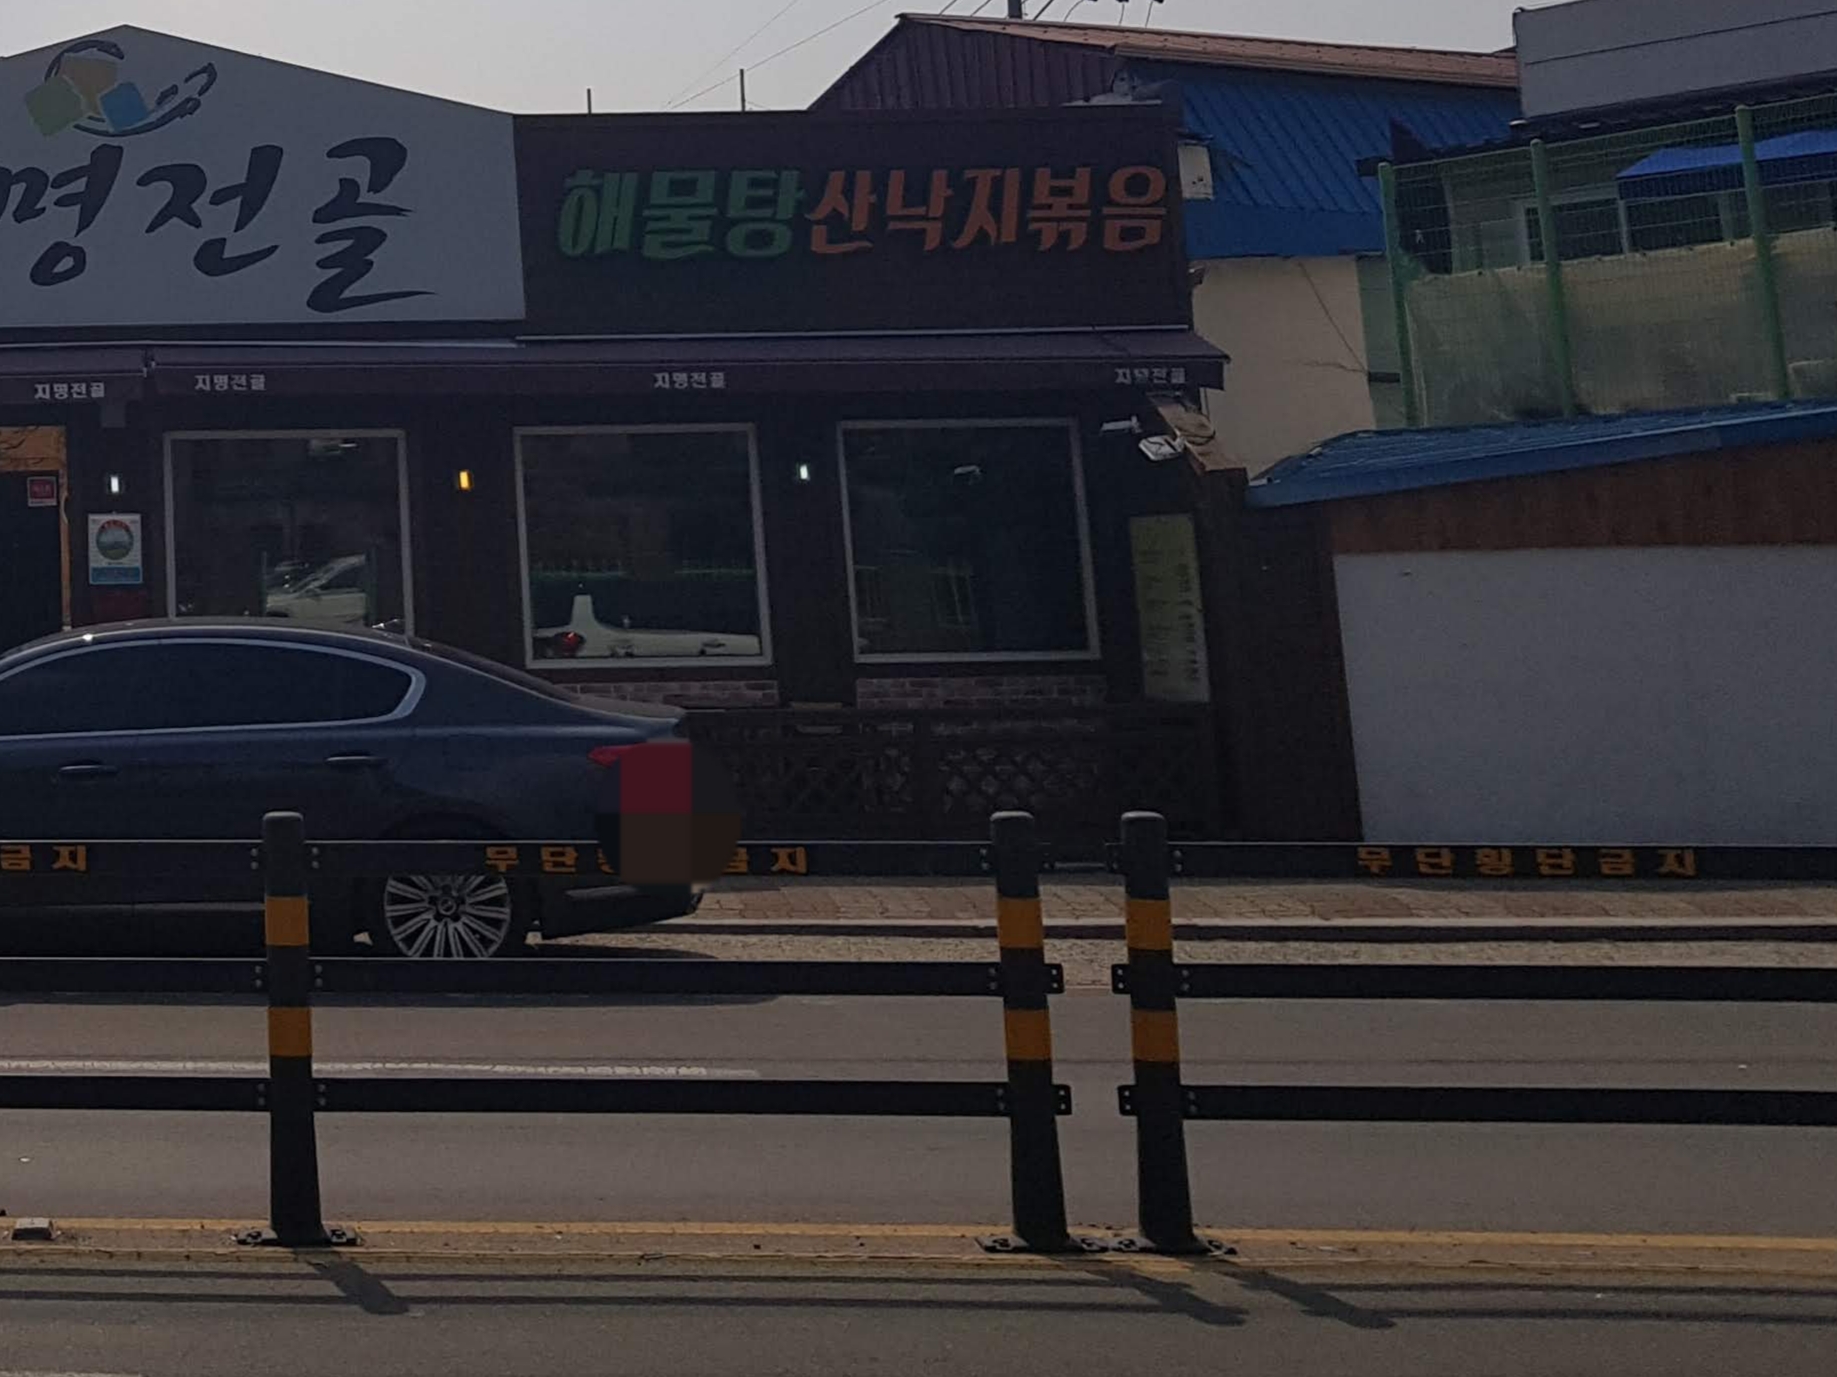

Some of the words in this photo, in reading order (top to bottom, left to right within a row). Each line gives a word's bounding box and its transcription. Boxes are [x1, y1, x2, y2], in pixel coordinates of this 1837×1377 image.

[555, 167, 805, 259] 해물탕
[806, 166, 1168, 254] 산낙지볶음
[194, 373, 267, 392] 지명전골
[653, 371, 726, 389] 지명전골
[33, 382, 105, 400] 지명전골
